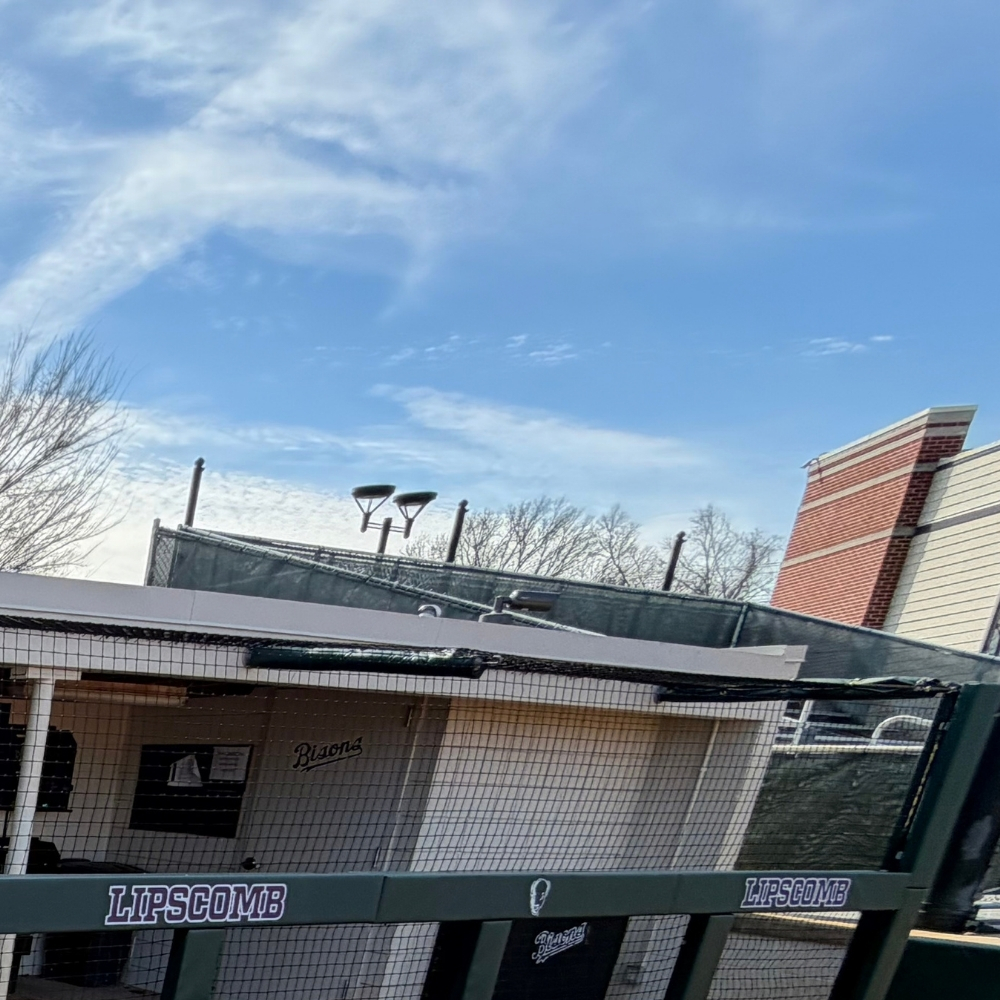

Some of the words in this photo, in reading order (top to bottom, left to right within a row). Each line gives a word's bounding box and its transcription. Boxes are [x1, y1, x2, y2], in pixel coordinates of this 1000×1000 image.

[293, 737, 362, 772] Bisons
[105, 884, 288, 925] LIPSCOMB
[741, 877, 852, 908] LIPSCOMB
